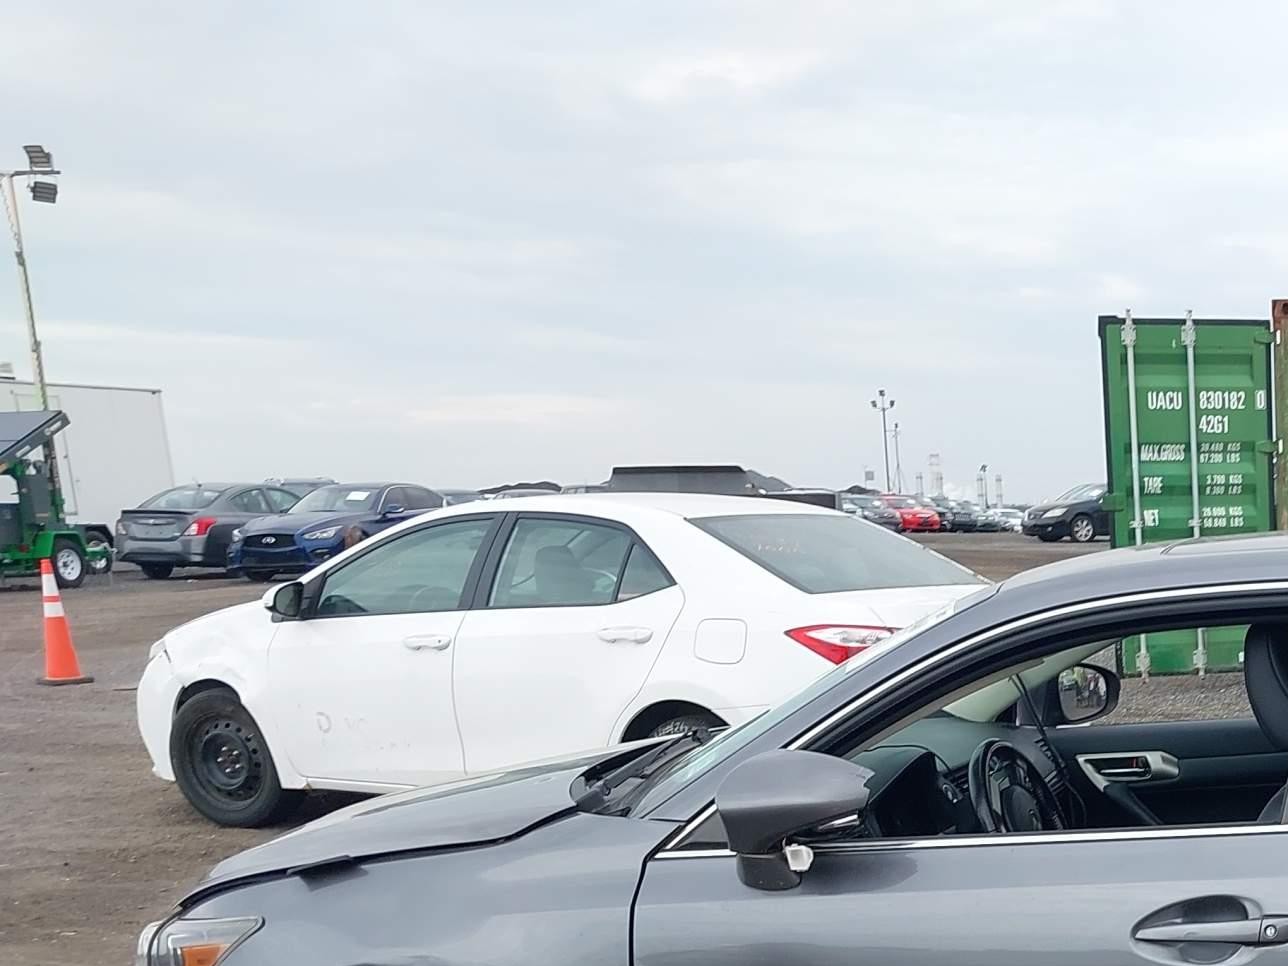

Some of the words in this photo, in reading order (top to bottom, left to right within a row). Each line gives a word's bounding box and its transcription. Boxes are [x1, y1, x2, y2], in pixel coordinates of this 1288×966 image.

[1147, 390, 1183, 410] UACU
[1199, 390, 1246, 410] 830182
[1256, 390, 1265, 410] 0
[1198, 414, 1229, 434] 42G1
[1140, 443, 1186, 462] MAX.GROSS
[1226, 453, 1241, 464] LBS
[1143, 476, 1163, 495] TARE
[1143, 508, 1160, 527] NET
[1230, 516, 1244, 528] LBS
